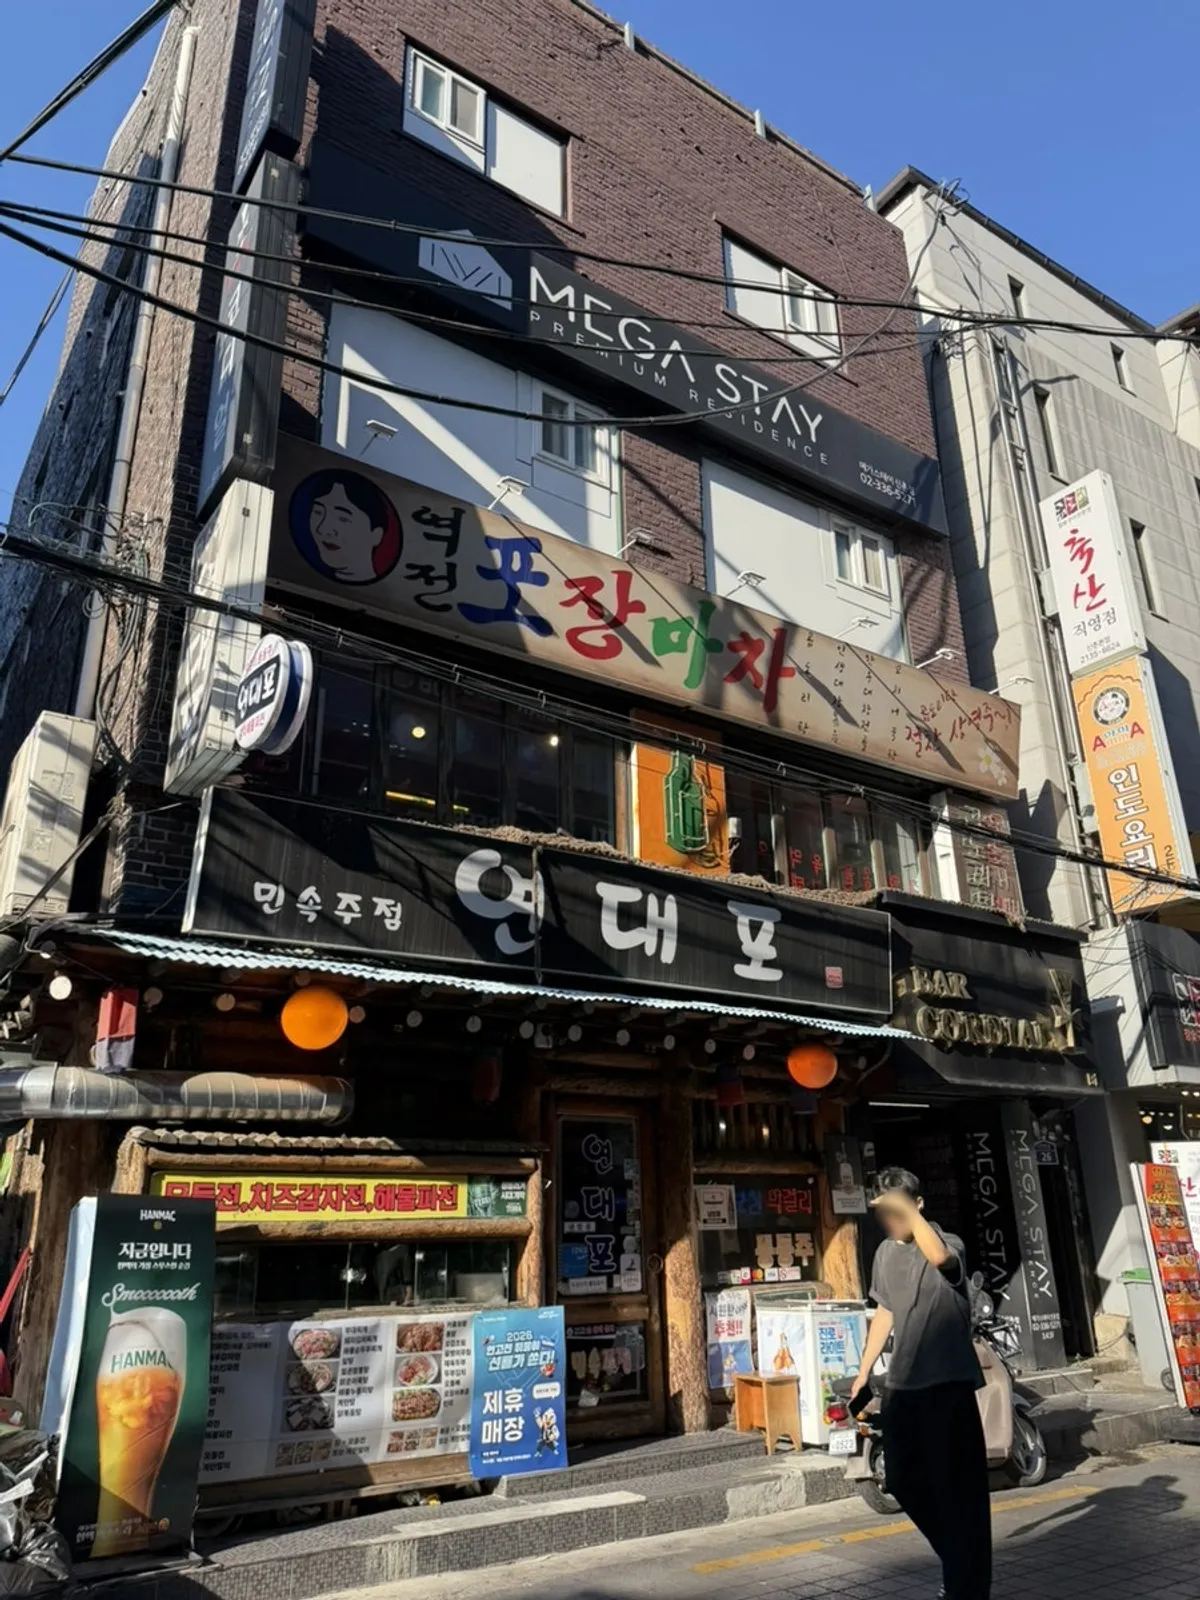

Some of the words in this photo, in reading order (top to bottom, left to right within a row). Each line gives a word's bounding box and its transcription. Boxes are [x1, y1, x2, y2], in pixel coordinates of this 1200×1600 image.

[530, 311, 668, 387] PREMIUM
[689, 389, 831, 467] RESIDENCE
[531, 266, 695, 383] MEGA
[715, 363, 823, 443] STAY
[404, 505, 466, 613] 역전
[457, 534, 797, 714] 포장마차
[1063, 528, 1108, 613] 축산
[1072, 607, 1118, 638] 직영점
[253, 880, 404, 933] 민속주점
[453, 848, 784, 983] 연대포
[910, 964, 973, 1000] BAR
[118, 1242, 192, 1260] 지금입니다
[139, 1209, 177, 1222] HANMAC
[581, 1132, 617, 1274] 연대포
[973, 1132, 999, 1217] MEGA
[986, 1228, 1011, 1301] STAY
[1015, 1129, 1039, 1215] MEGA
[1029, 1226, 1052, 1298] STAY
[481, 1416, 526, 1444] 매장
[482, 1388, 525, 1415] 제휴
